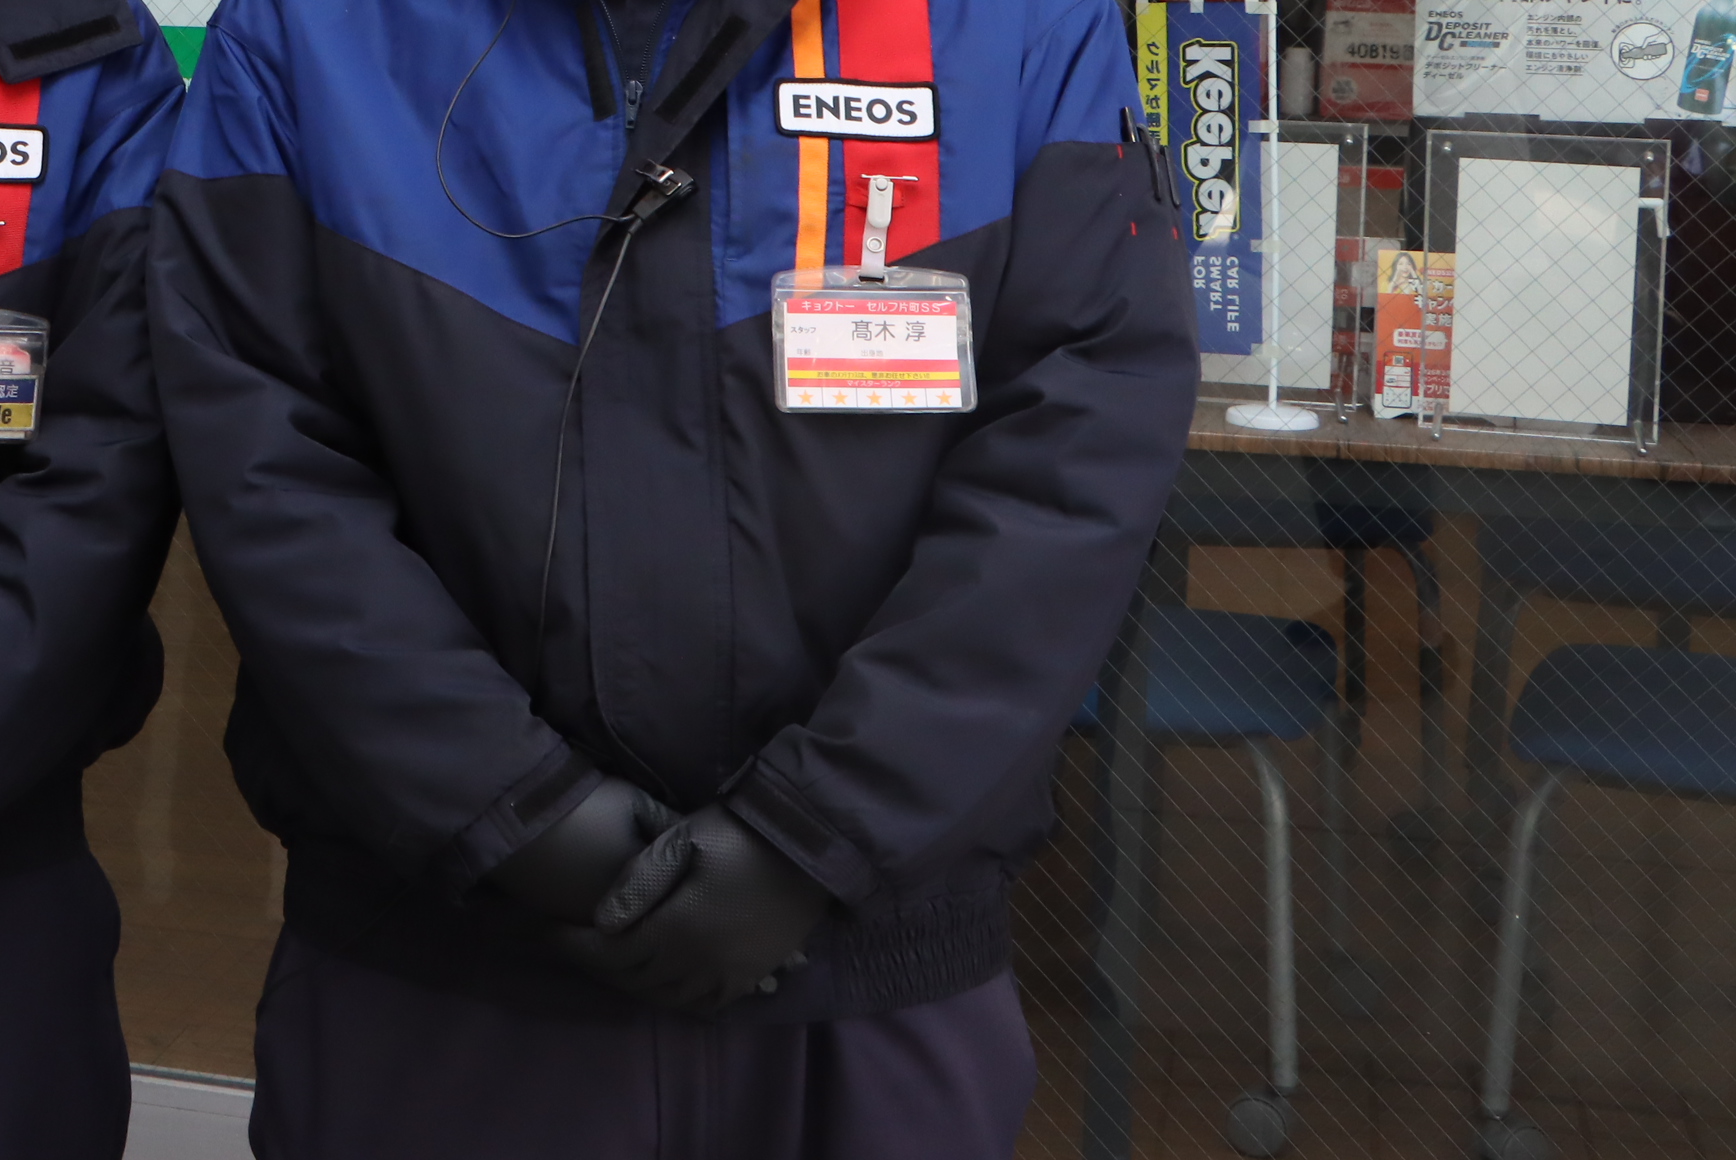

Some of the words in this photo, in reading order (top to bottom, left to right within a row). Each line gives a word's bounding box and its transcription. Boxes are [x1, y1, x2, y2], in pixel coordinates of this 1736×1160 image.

[1428, 10, 1464, 19] ENEOS
[792, 94, 918, 126] ENEOS
[801, 301, 855, 312] キョクトー
[790, 326, 817, 334] スタッフ
[905, 321, 927, 342] 淳
[846, 380, 901, 388] マイスターランク
